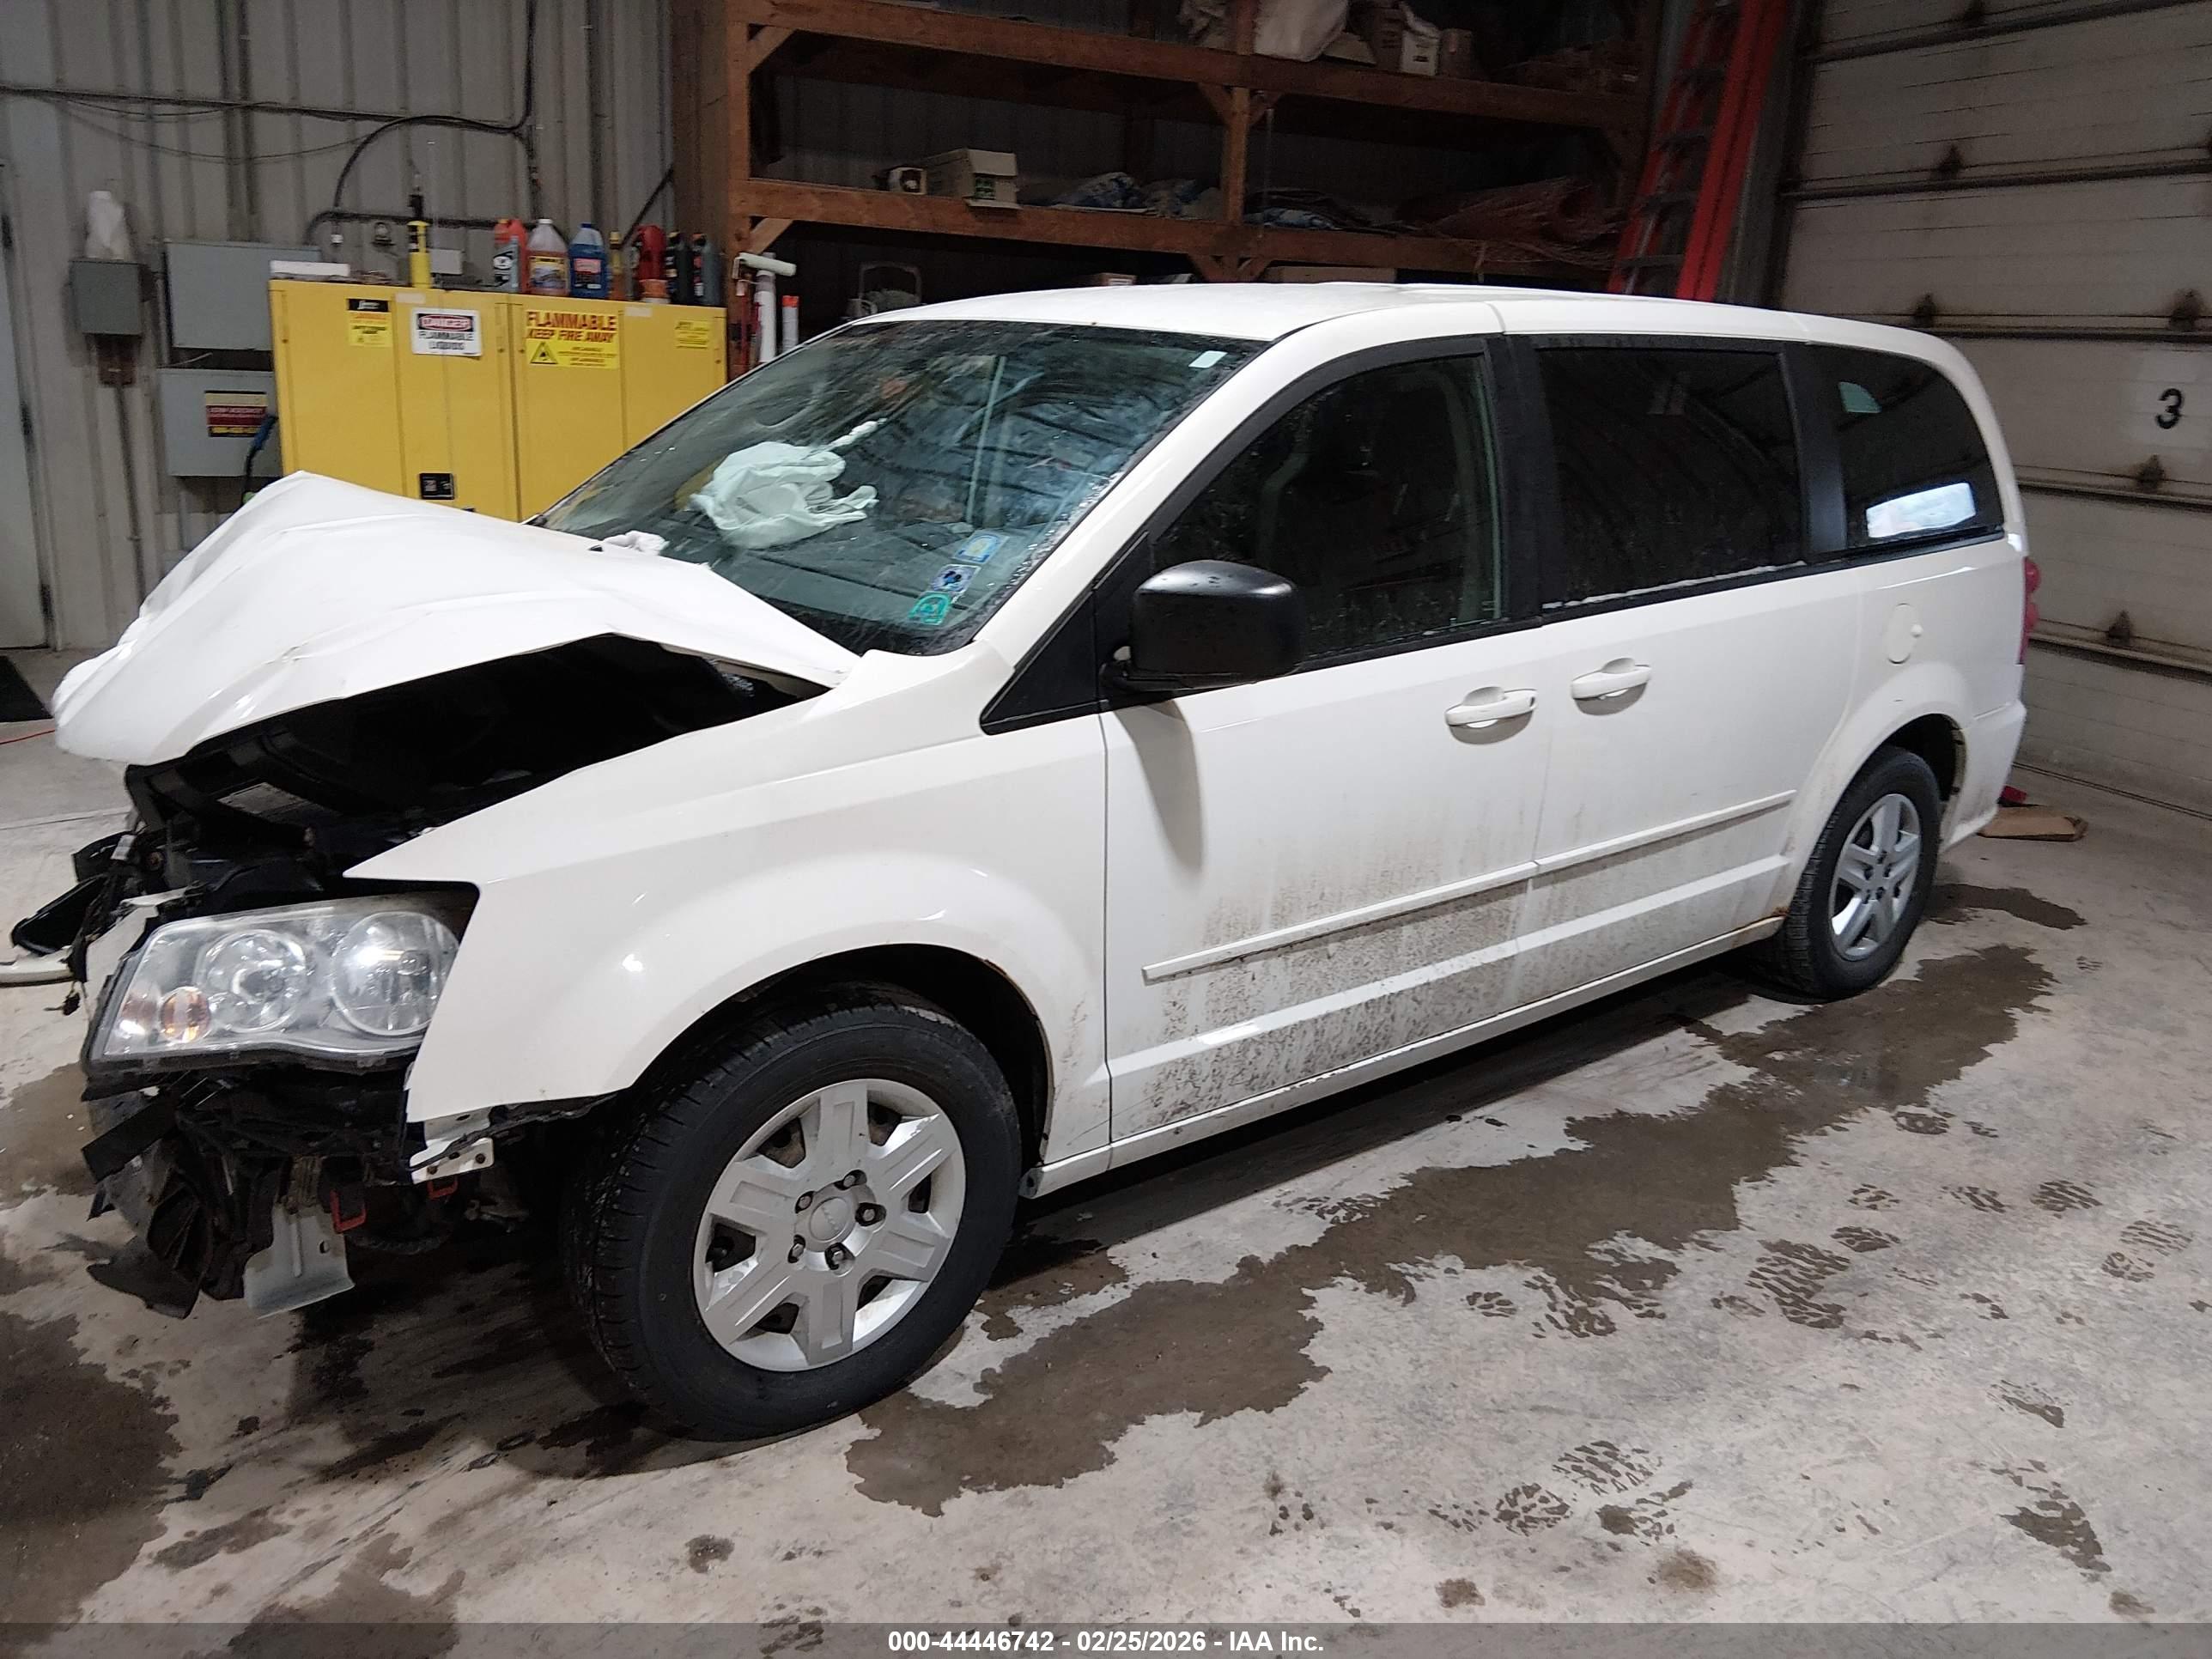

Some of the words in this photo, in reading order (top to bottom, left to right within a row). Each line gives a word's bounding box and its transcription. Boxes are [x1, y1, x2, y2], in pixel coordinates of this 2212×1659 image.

[526, 311, 617, 331] FLAMMABLE
[526, 328, 555, 340] KEEP
[557, 330, 584, 342] FIRE
[585, 331, 616, 343] AWAY
[2155, 388, 2183, 429] 3
